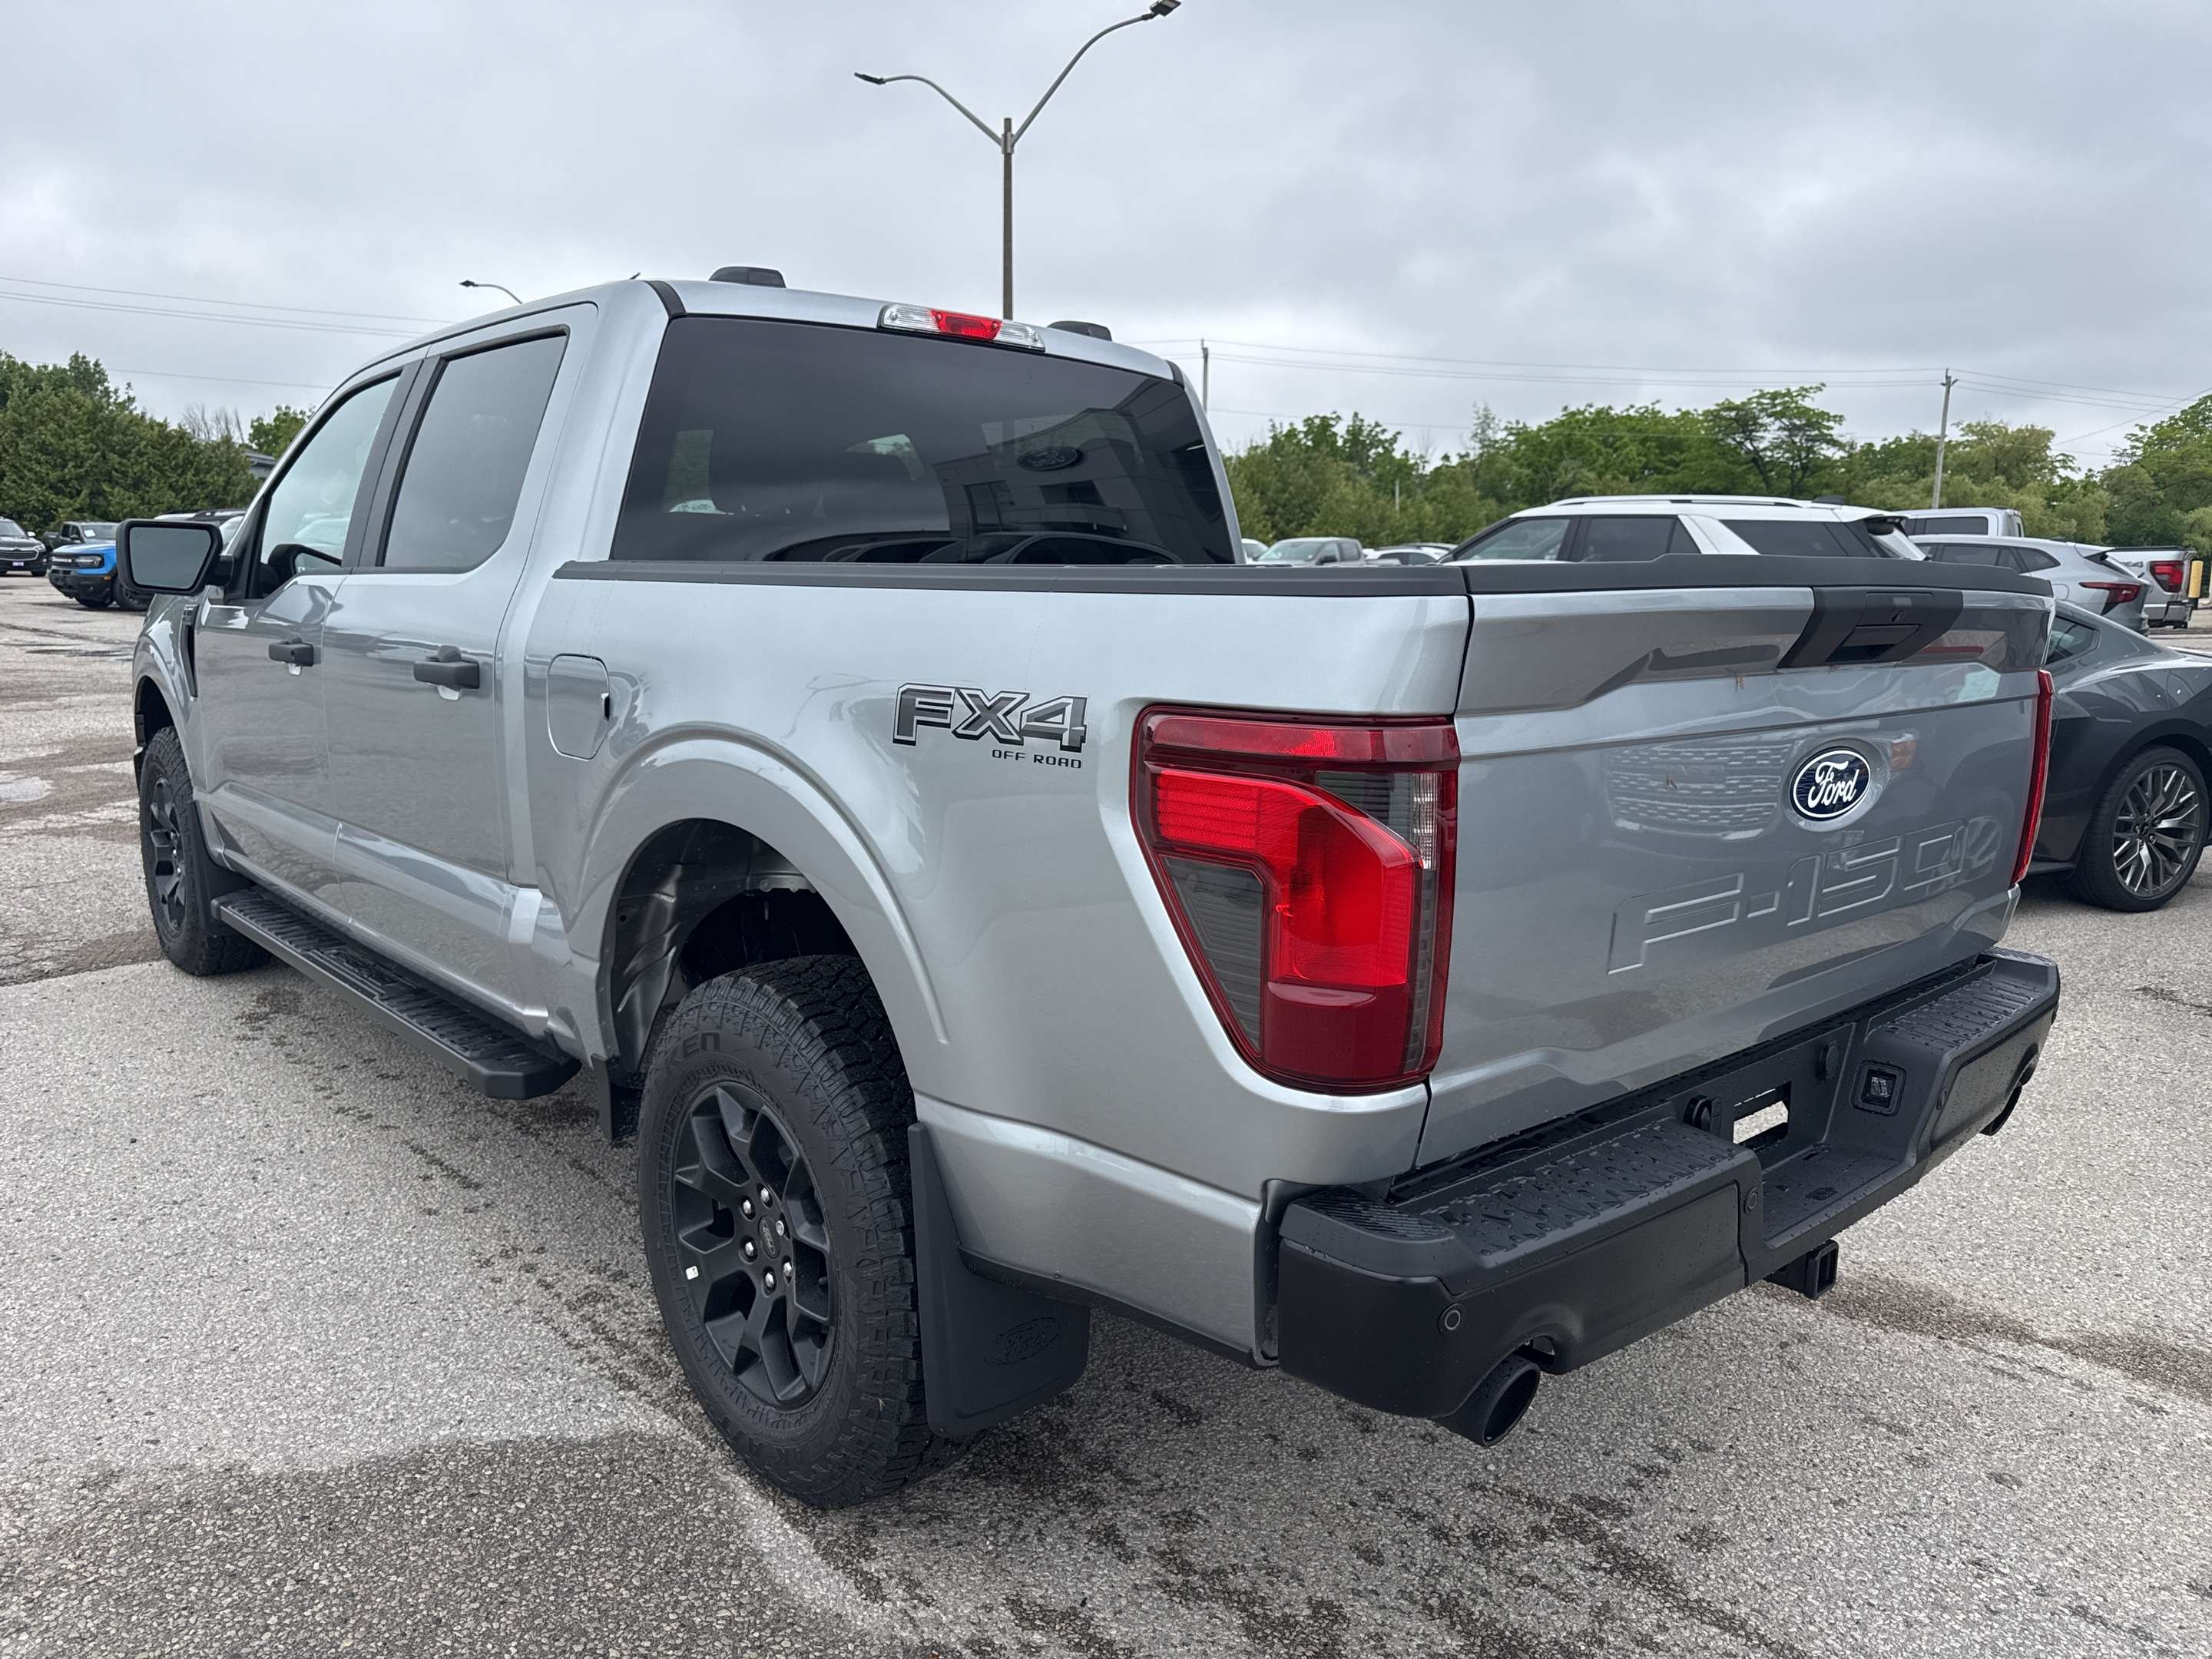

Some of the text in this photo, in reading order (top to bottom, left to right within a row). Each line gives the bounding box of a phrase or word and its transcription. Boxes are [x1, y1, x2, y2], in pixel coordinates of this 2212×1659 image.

[892, 682, 1088, 753] FX4
[992, 749, 1082, 770] OFF ROAD
[1807, 760, 1859, 808] Ford
[1607, 819, 1968, 975] F-150
